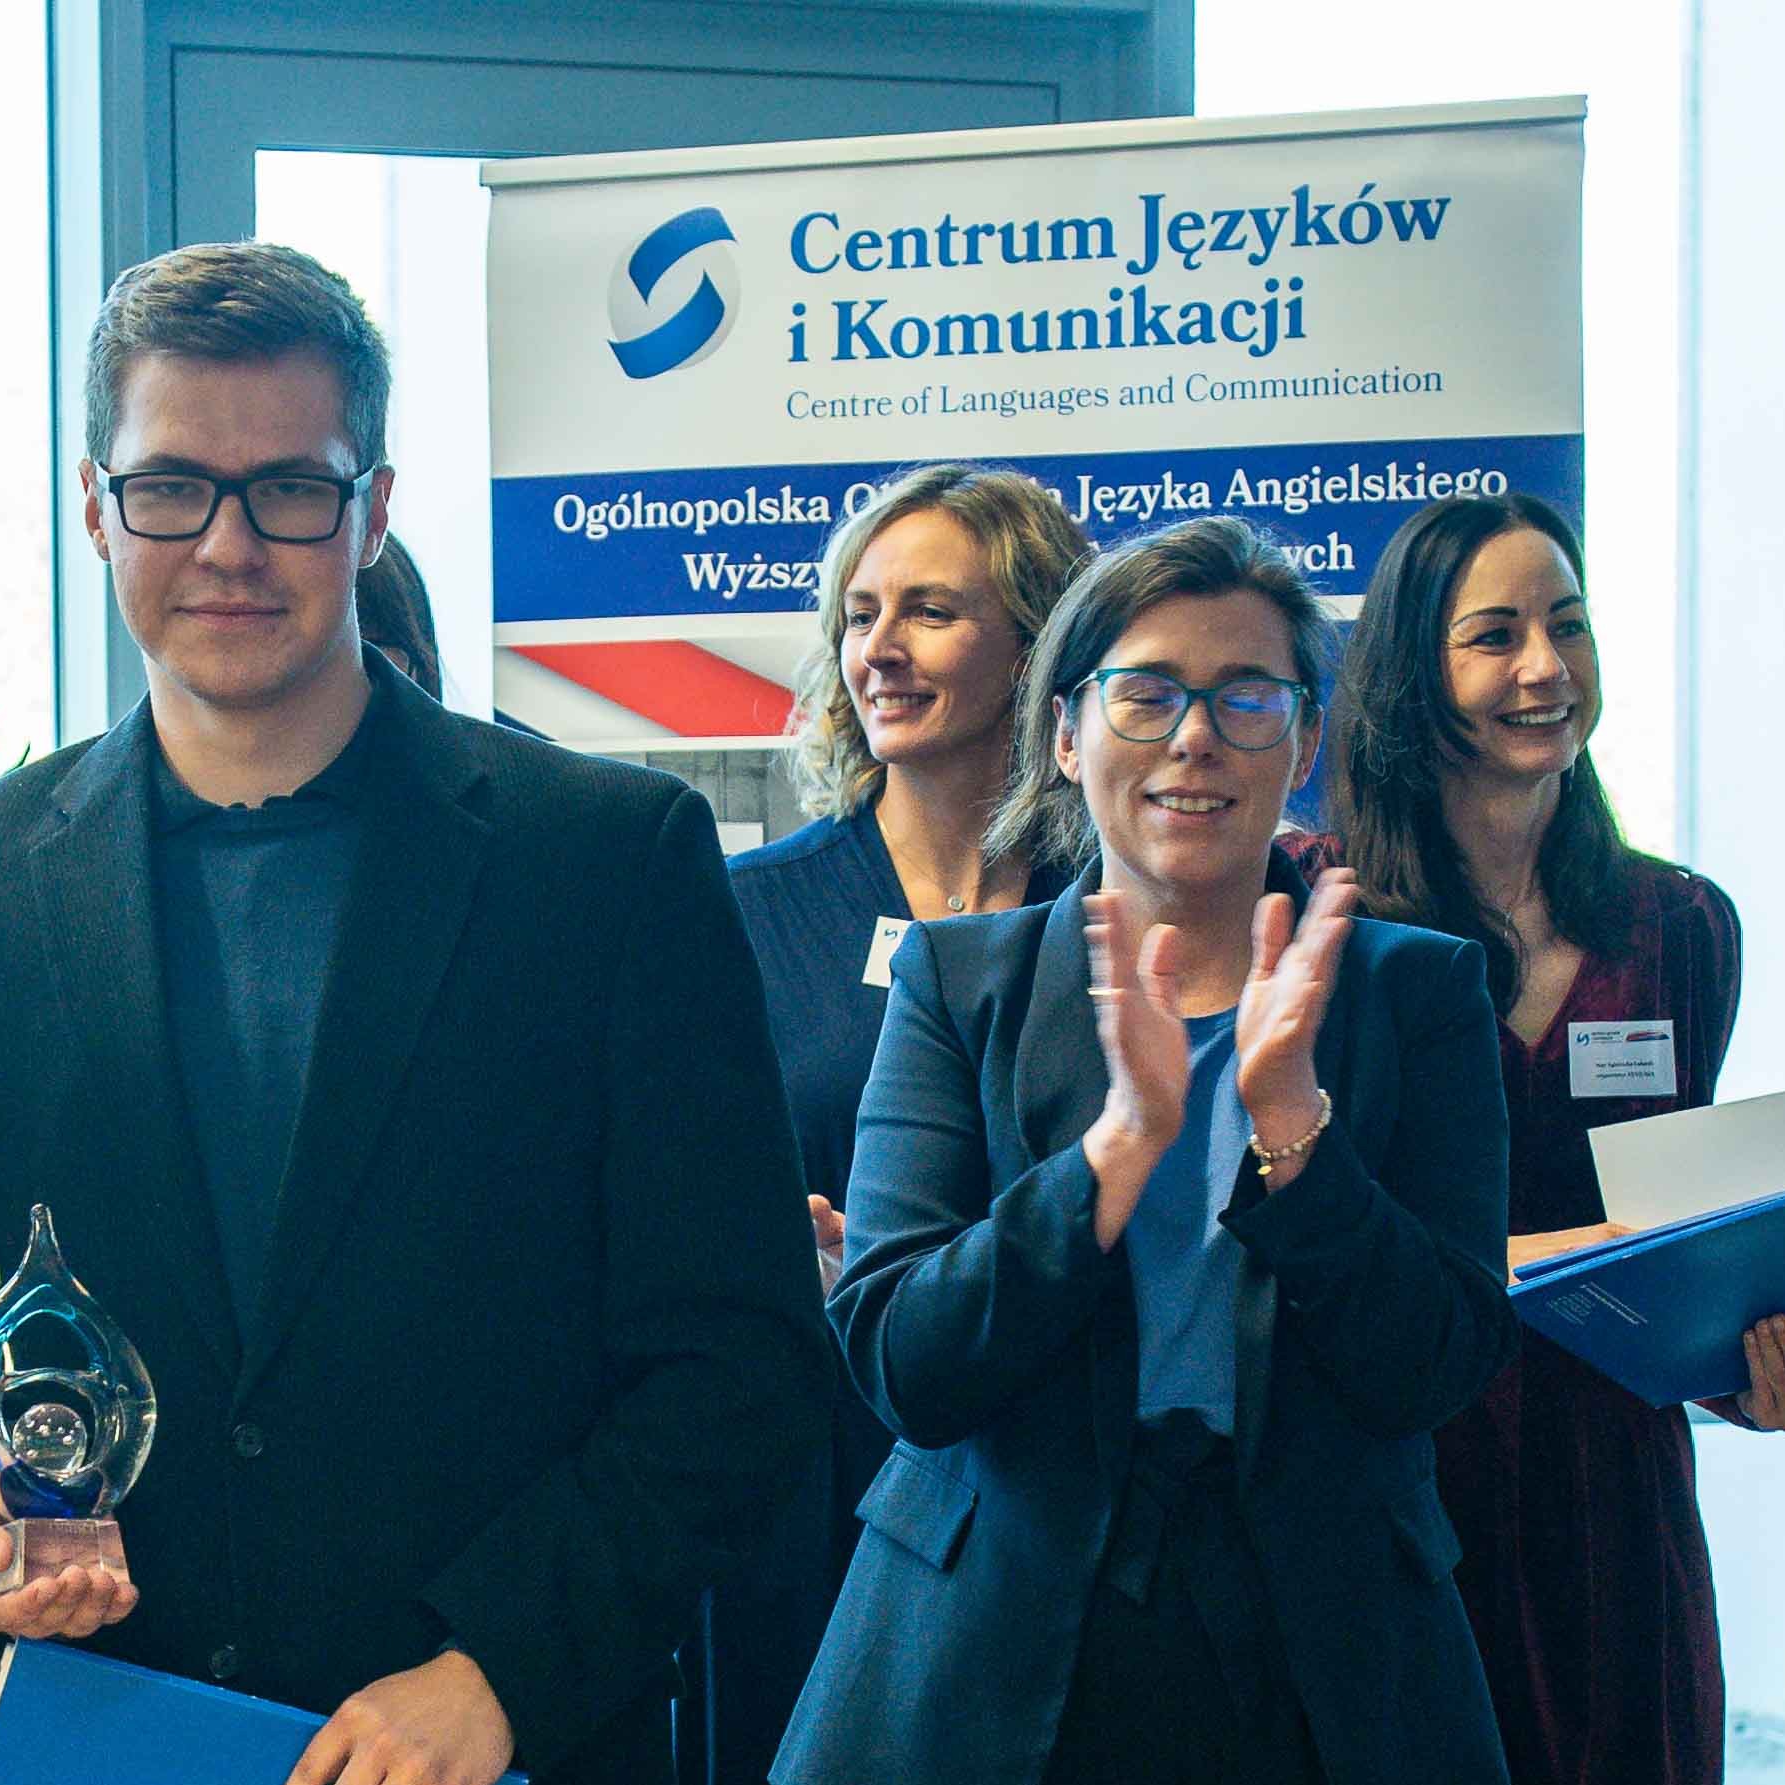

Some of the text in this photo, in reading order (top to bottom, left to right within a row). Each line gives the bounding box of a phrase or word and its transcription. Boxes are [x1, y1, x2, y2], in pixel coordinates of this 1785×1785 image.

[790, 182, 1452, 275] Centrum Języków
[788, 276, 1307, 362] i Komunikacji
[787, 365, 1444, 419] Centre of Languages and Communication
[553, 485, 832, 540] Ogólnopolska
[1070, 470, 1212, 523] Języka
[1223, 462, 1509, 515] Angielskiego
